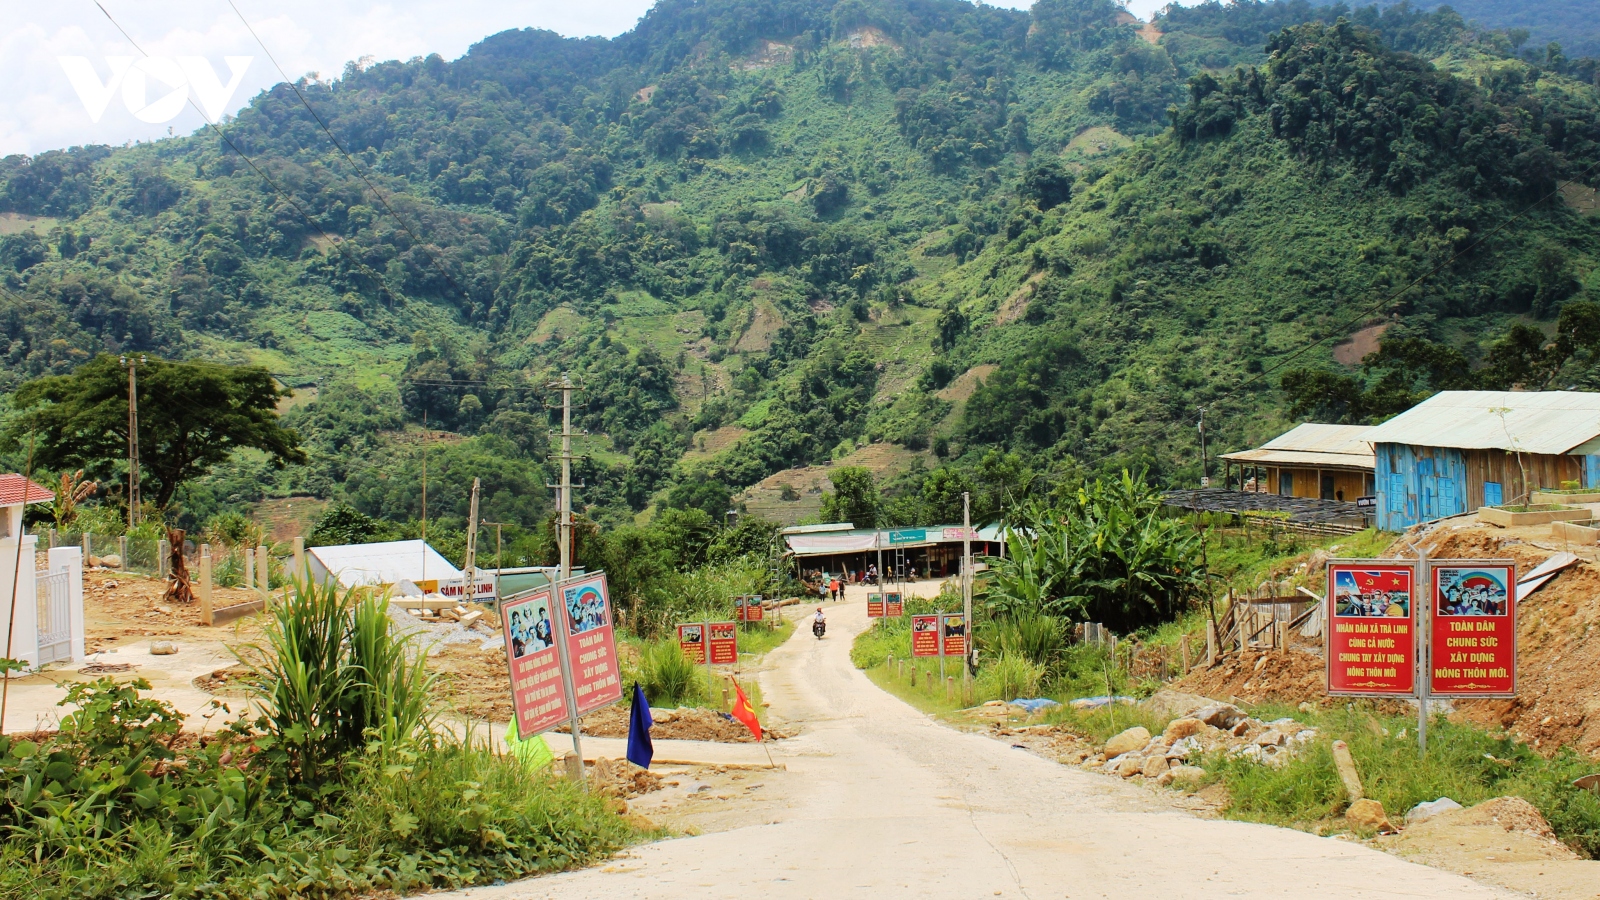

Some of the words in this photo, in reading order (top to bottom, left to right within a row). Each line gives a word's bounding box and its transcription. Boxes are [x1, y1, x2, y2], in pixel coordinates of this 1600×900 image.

[478, 584, 492, 594] LINH
[1336, 622, 1354, 633] NHÂN
[1355, 622, 1368, 633] DÂN
[1370, 623, 1378, 633] XÃ
[1380, 623, 1392, 633] TRÀ
[1394, 625, 1408, 634] LINH
[1450, 620, 1474, 631] TOÀN
[1476, 620, 1495, 631] DÂN
[579, 636, 593, 648] TOÀN
[593, 632, 604, 644] DÂN
[1349, 637, 1366, 648] CÙNG
[1368, 636, 1376, 648] CẢ
[1378, 638, 1395, 648] NƯỚC
[1447, 637, 1477, 647] CHUNG
[1480, 636, 1498, 647] SỨC
[580, 650, 597, 664] CHUNG
[597, 646, 607, 658] SỨC
[1339, 653, 1360, 662] CHUNG
[1362, 654, 1372, 662] TAY
[1373, 652, 1386, 663] XÂY
[1387, 653, 1404, 665] DỰNG
[1450, 651, 1467, 662] XÂY
[1470, 652, 1494, 664] DỰNG
[584, 666, 594, 679] XÂY
[595, 662, 608, 675] DỰNG
[1347, 666, 1364, 676] NÔNG
[1366, 667, 1382, 677] THÔN
[1384, 667, 1396, 677] MỚI
[1435, 667, 1460, 678] NÔNG
[1463, 667, 1486, 678] THÔN
[1489, 667, 1509, 678] MỚI.
[577, 684, 592, 697] NÔNG
[592, 678, 606, 691] THÔN
